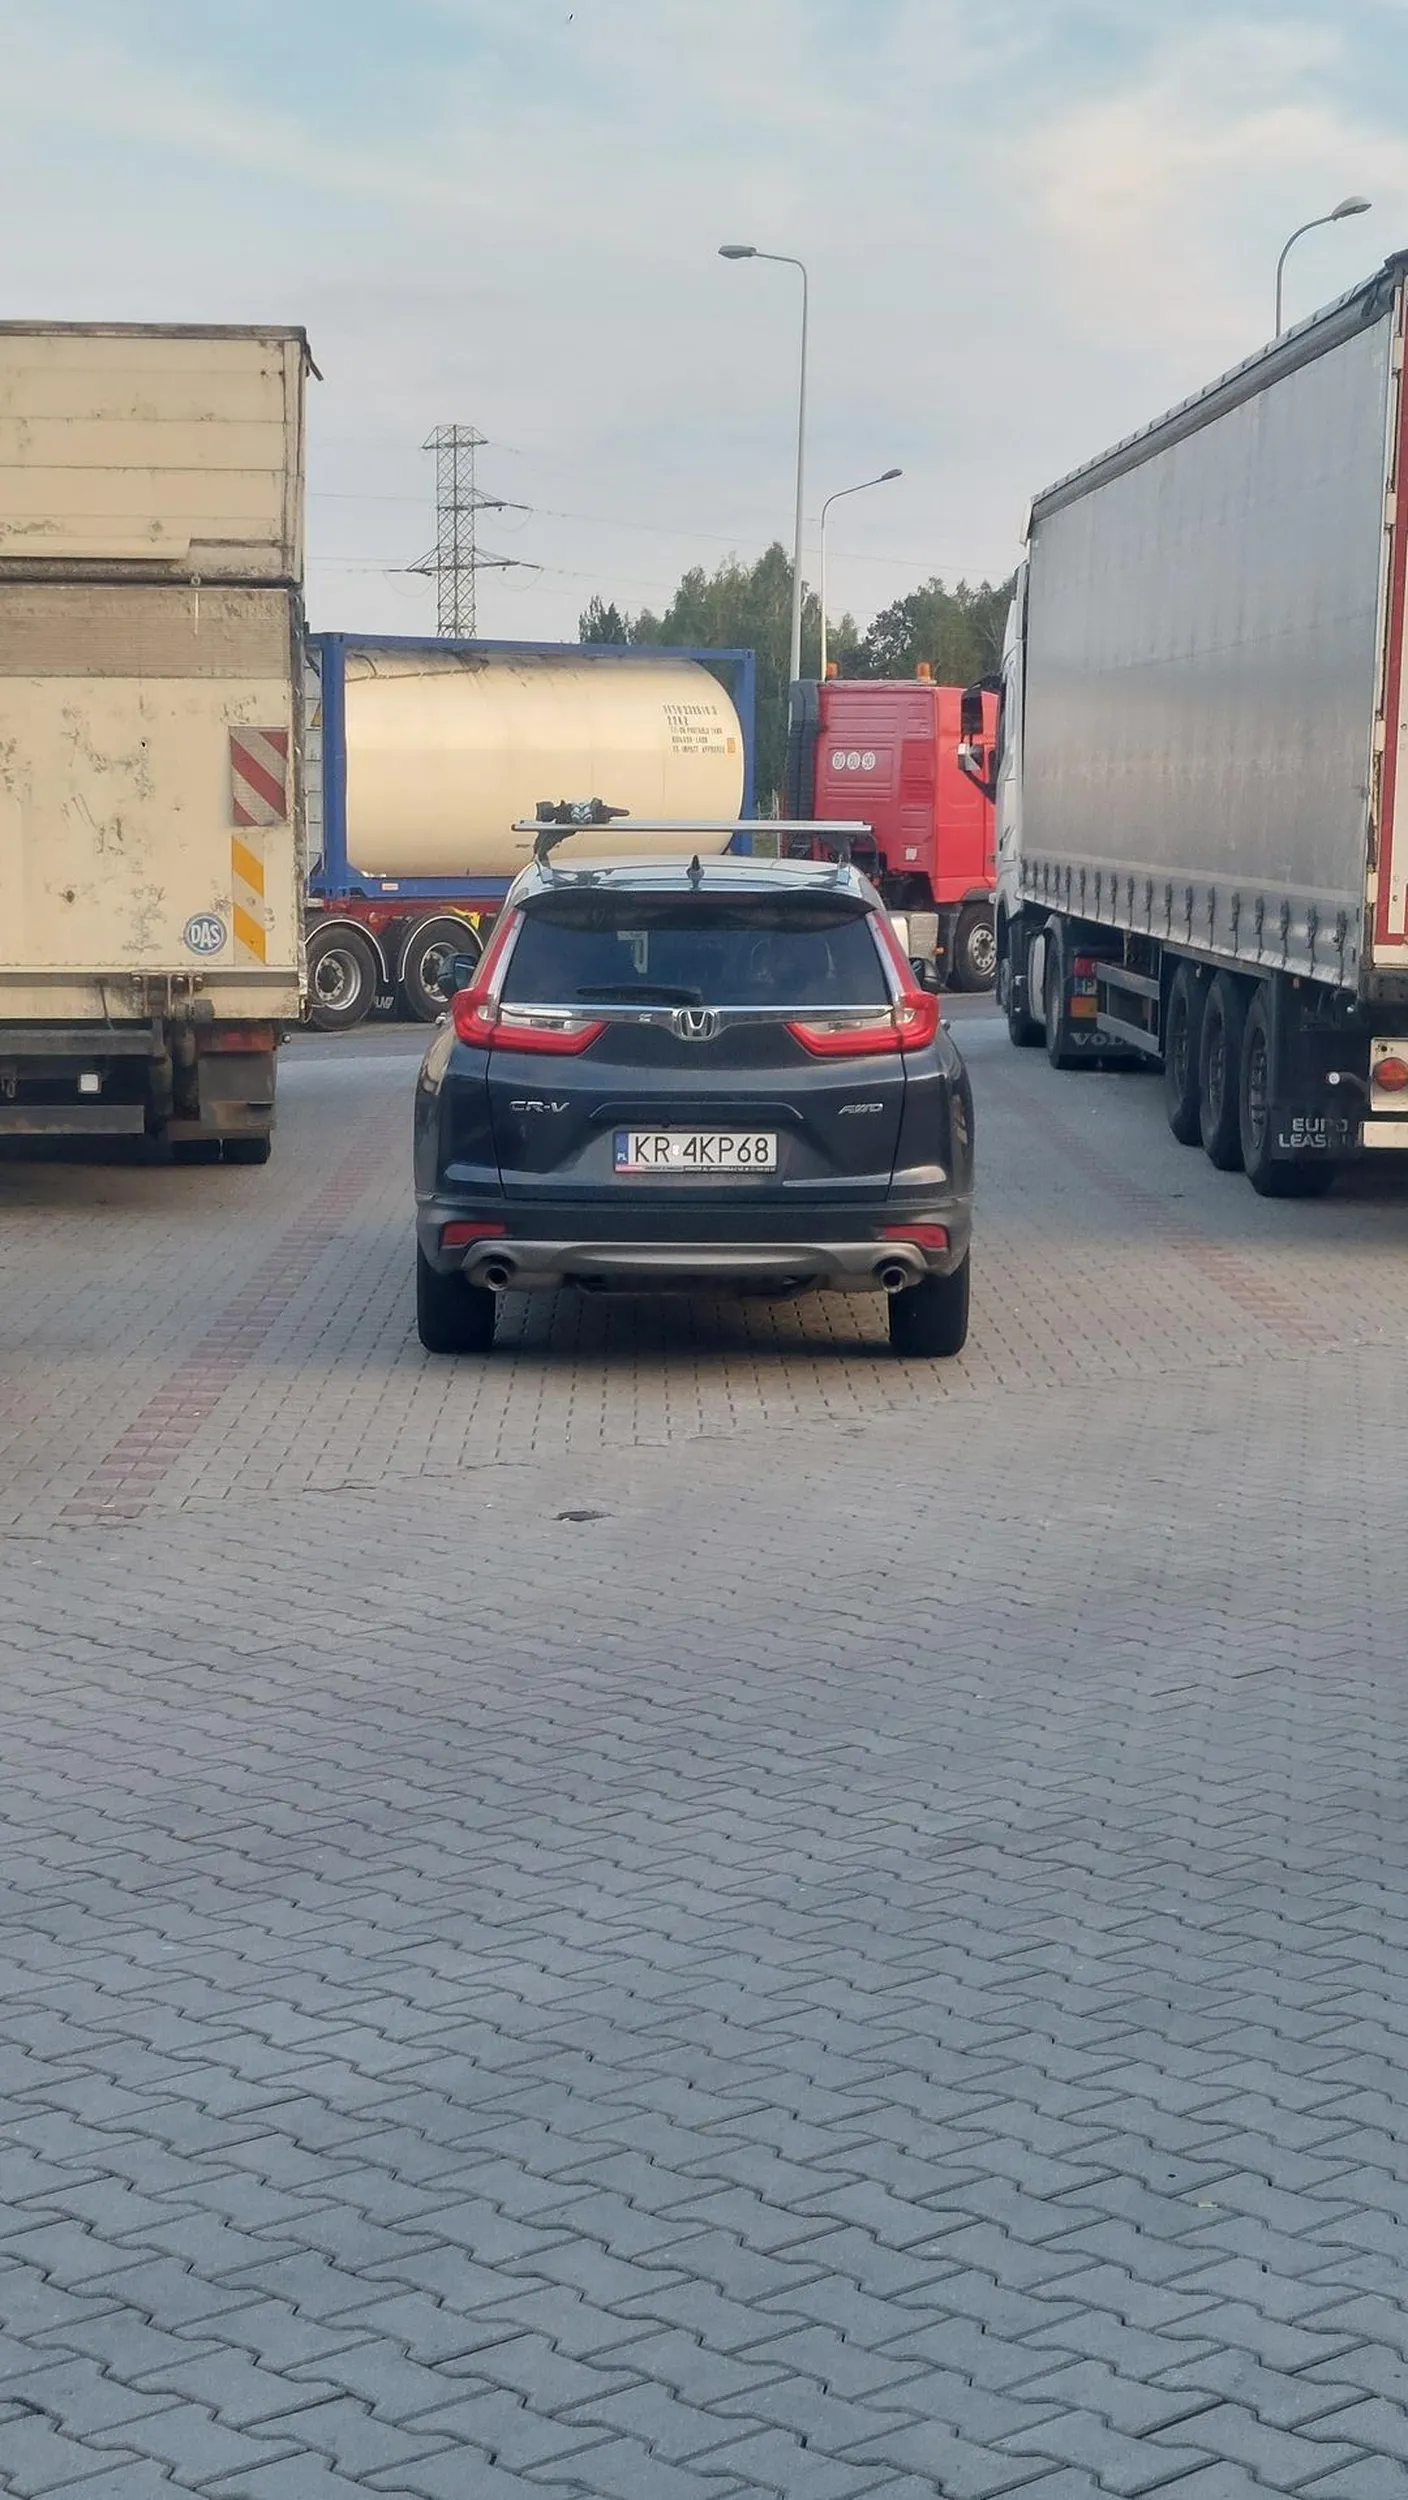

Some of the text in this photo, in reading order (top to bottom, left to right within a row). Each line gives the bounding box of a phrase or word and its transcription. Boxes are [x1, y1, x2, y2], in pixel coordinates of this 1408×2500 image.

[191, 921, 220, 948] DAS
[1070, 1032, 1125, 1046] VOL
[510, 1100, 570, 1113] CR-V
[838, 1103, 884, 1115] AWD
[635, 1136, 769, 1163] KR 4KP68
